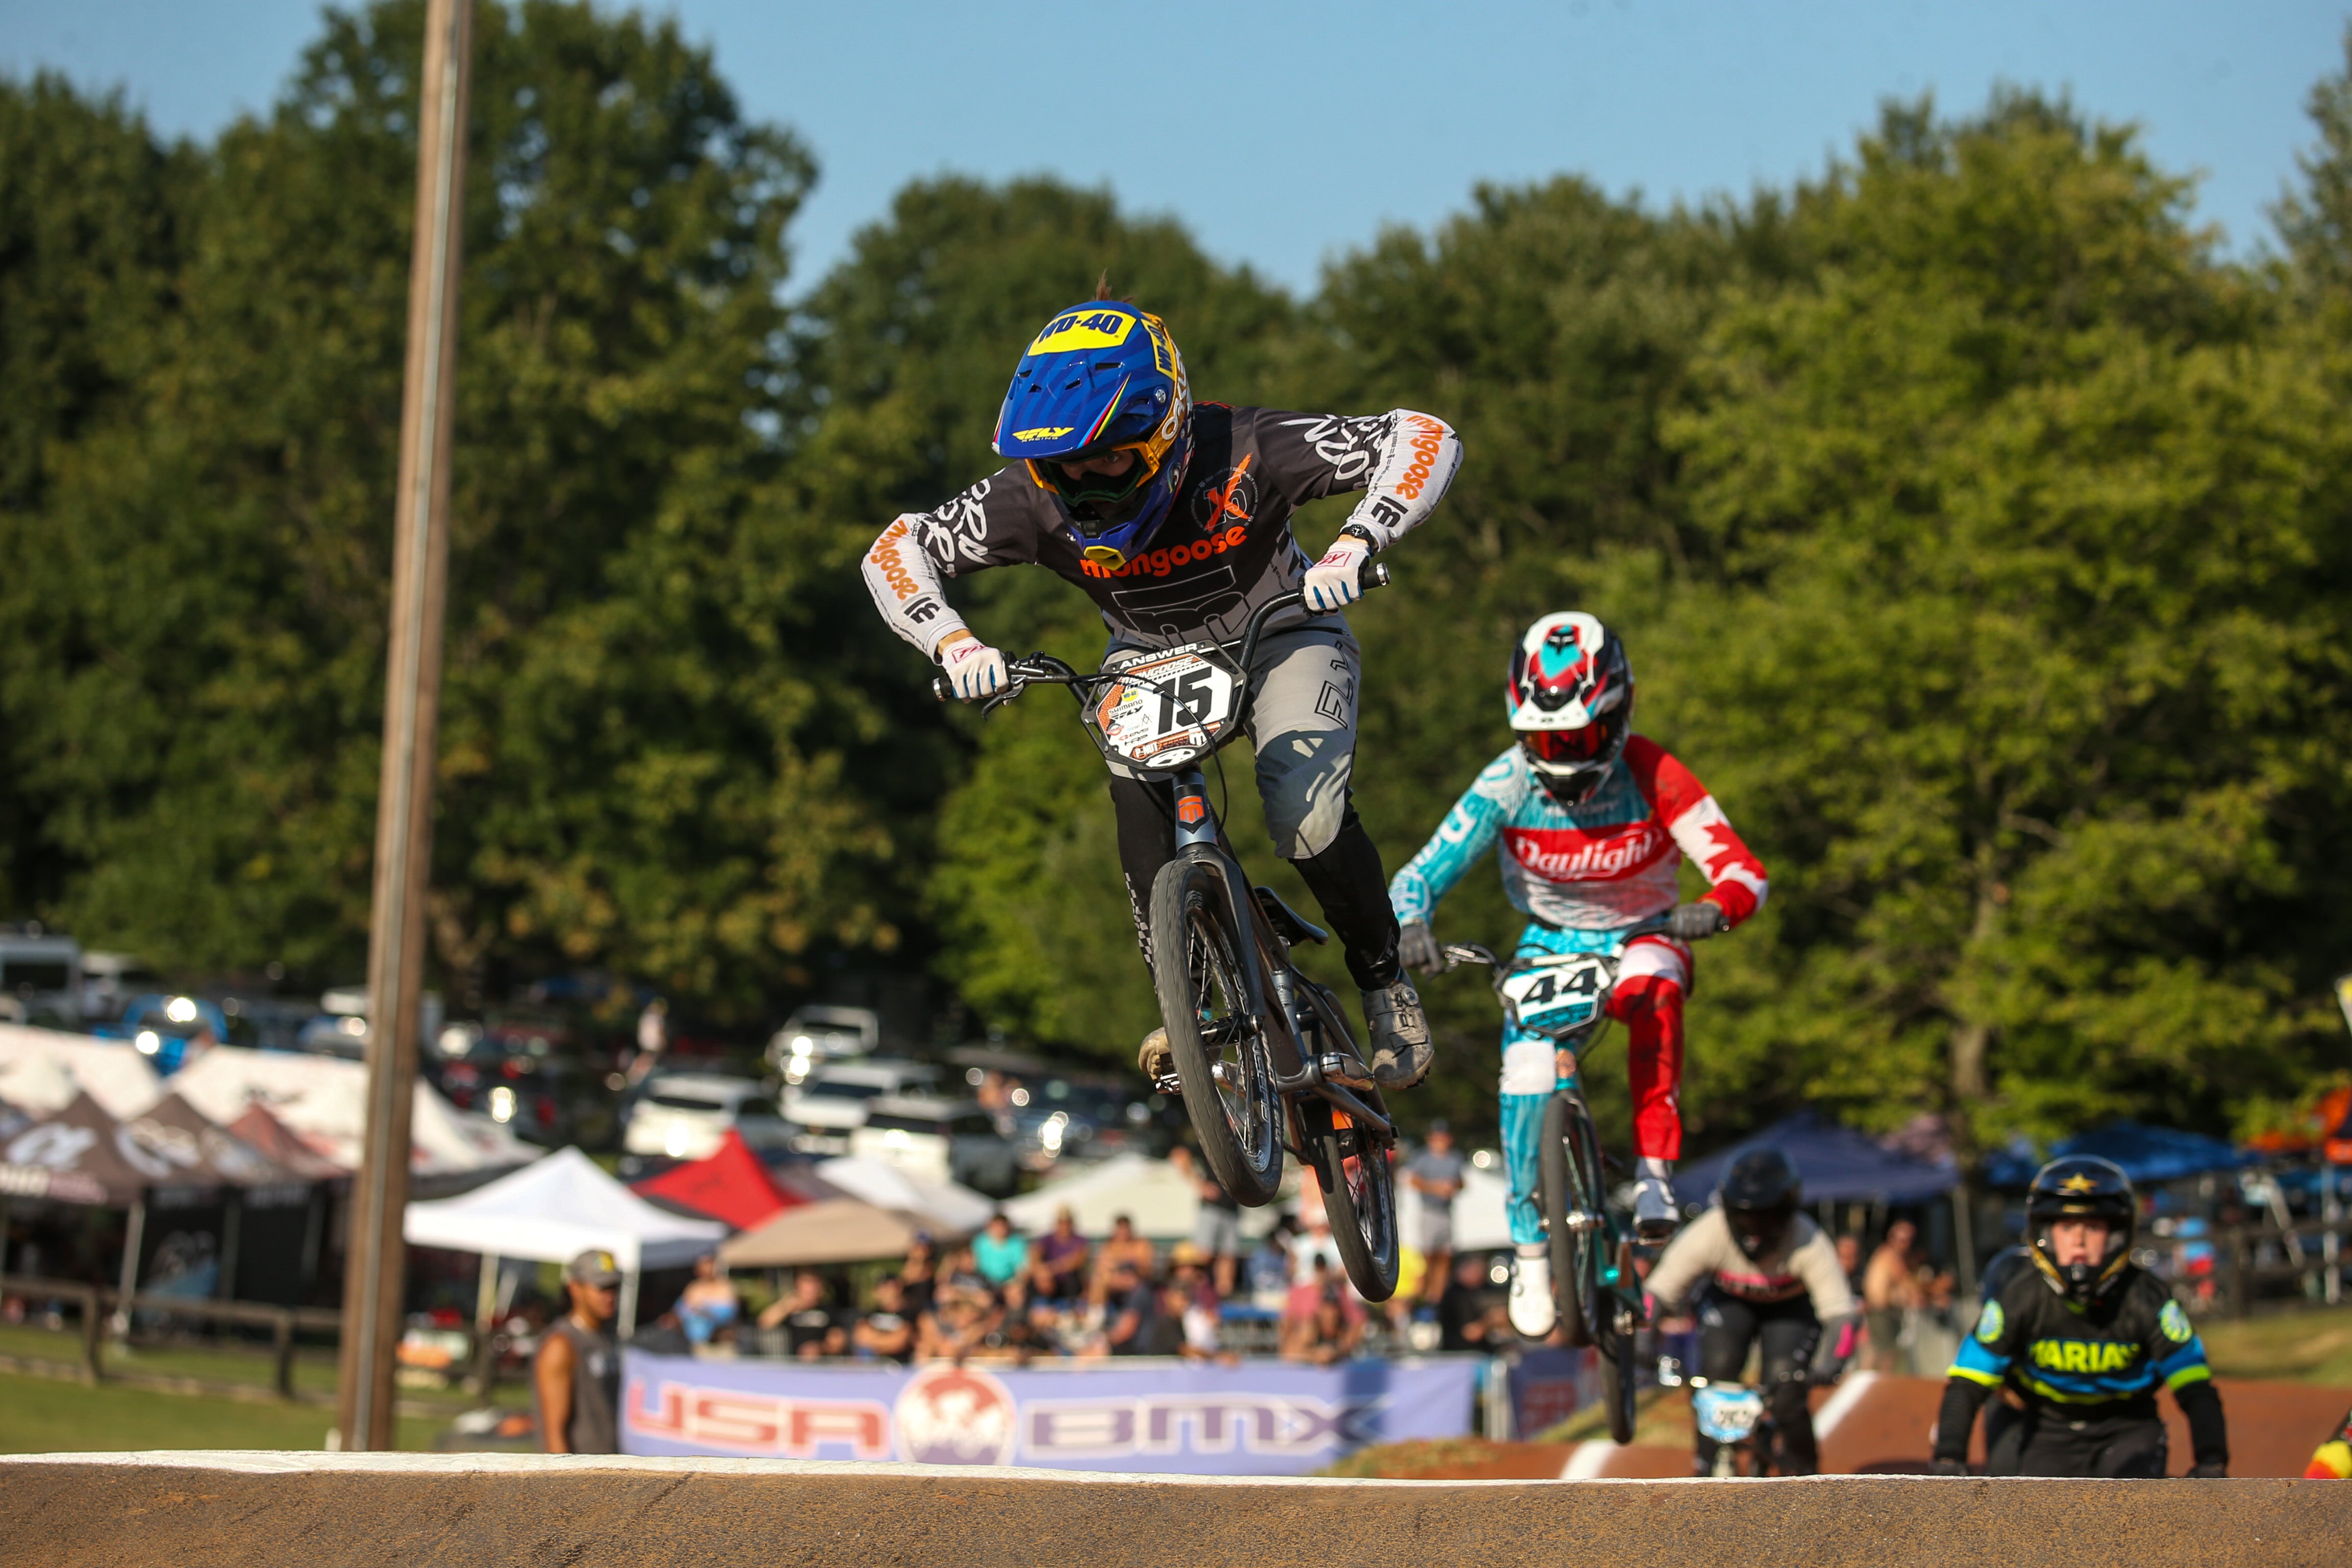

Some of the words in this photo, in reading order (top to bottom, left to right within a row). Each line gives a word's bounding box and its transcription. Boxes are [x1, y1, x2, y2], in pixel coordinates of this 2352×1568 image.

[1038, 313, 1123, 344] WD-40
[1012, 427, 1074, 440] FLY
[1395, 415, 1444, 500] mongoose
[870, 520, 919, 601] mongoose
[1119, 643, 1197, 670] ANSWER
[1120, 655, 1194, 685] MONGOOSE
[1109, 699, 1143, 714] SHIMANO
[1153, 666, 1213, 736] 15
[1135, 741, 1159, 758] P-NUT
[1521, 967, 1598, 1004] 44
[627, 1378, 891, 1458] USA
